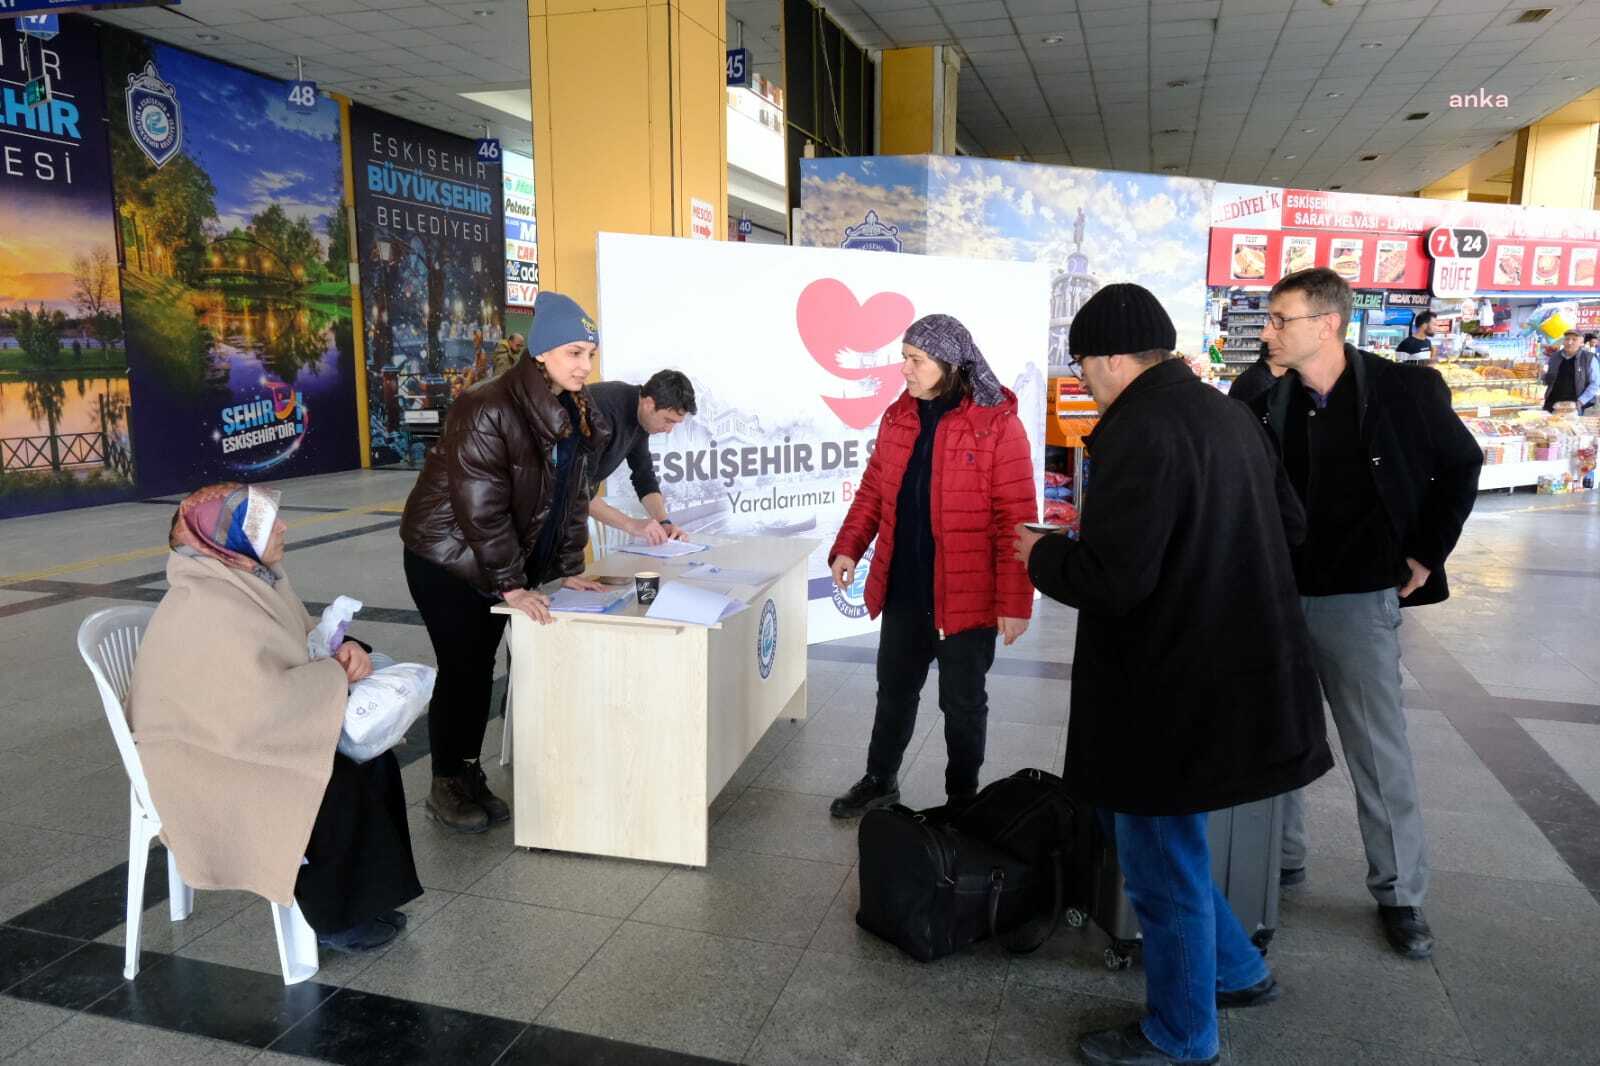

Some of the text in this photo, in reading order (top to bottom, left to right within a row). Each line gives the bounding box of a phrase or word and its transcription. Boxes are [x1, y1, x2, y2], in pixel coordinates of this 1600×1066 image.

[727, 54, 744, 79] 45
[288, 86, 316, 107] 48
[372, 132, 487, 180] ESKİŞEHİR
[478, 142, 498, 159] 46
[367, 160, 494, 216] BÜYÜKŞEHİR
[377, 206, 489, 243] BELEDİYESİ
[1295, 211, 1332, 226] SARAY
[1436, 236, 1447, 252] 7
[1462, 235, 1483, 252] 24
[1440, 260, 1473, 291] BÜFE
[222, 395, 275, 435] ŞEHİR
[222, 420, 296, 453] ESKİŞEHİR'DİR
[821, 440, 859, 471] DE
[727, 487, 835, 514] Yaralarımızı
